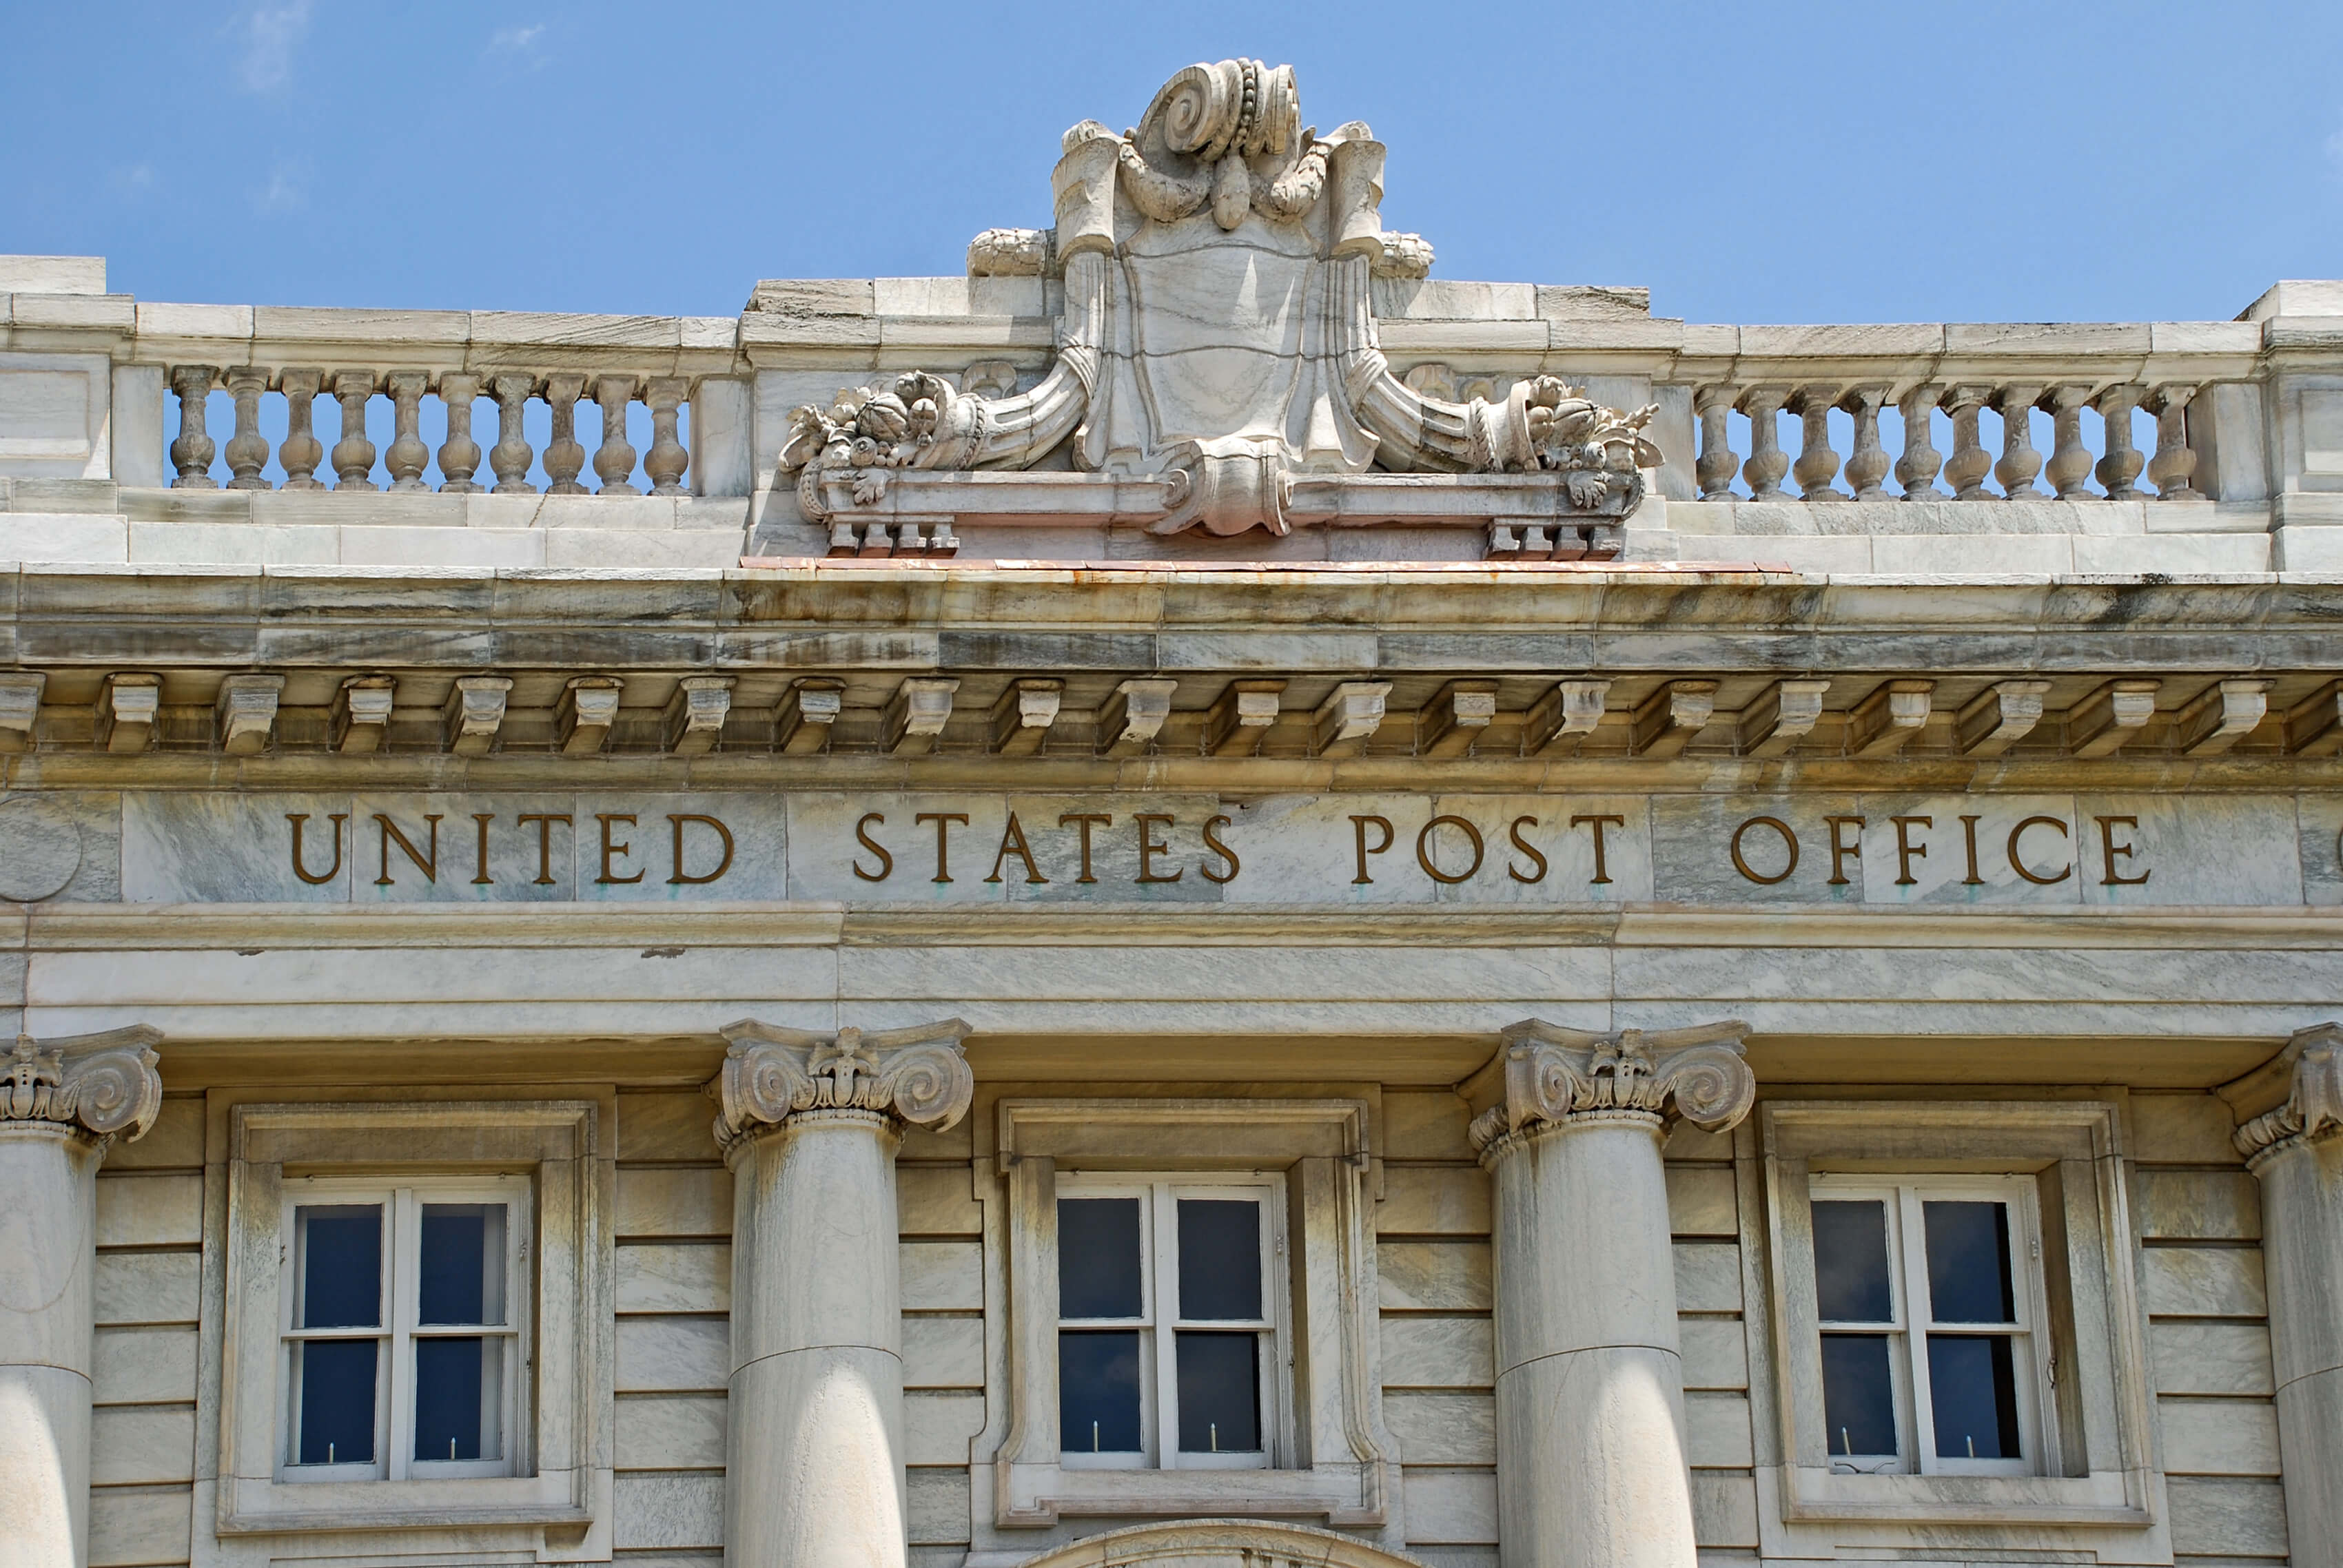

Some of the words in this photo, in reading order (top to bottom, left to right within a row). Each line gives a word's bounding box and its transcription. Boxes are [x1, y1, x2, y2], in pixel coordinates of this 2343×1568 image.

[285, 814, 735, 884] UNITED
[853, 811, 1240, 883] STATES
[1348, 814, 1624, 884] POST
[1730, 815, 2151, 885] OFFICE
